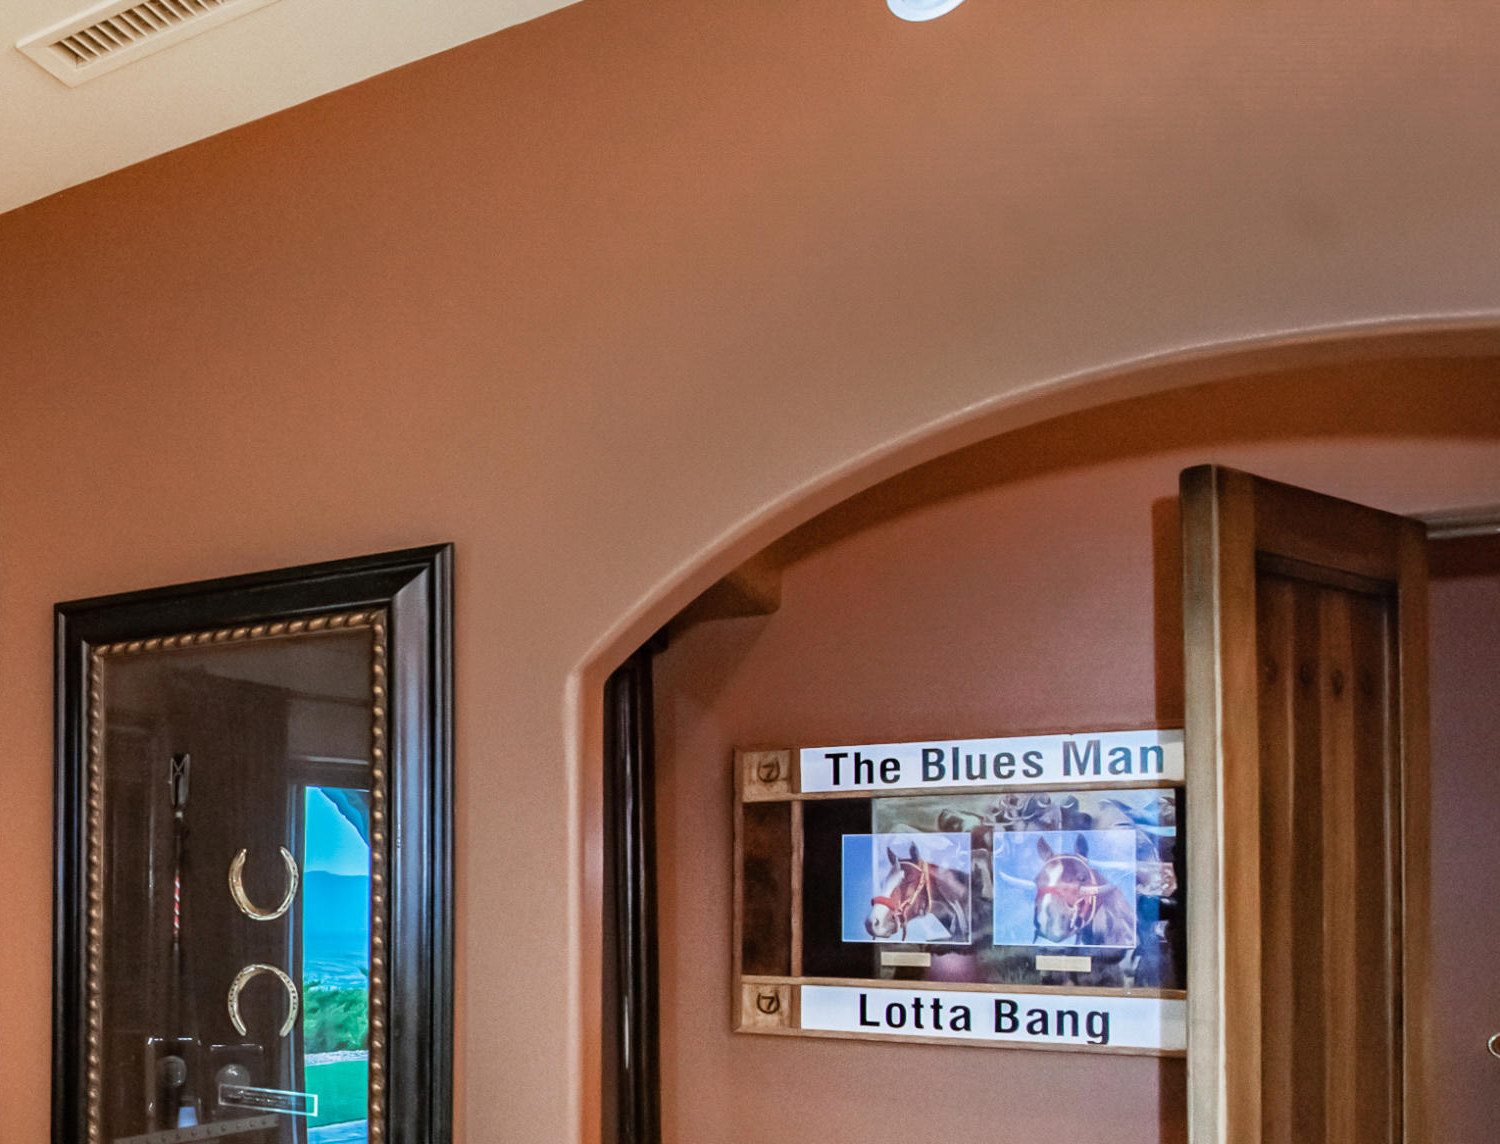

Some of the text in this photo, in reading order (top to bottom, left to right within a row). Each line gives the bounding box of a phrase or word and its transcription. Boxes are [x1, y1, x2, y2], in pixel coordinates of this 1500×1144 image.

[825, 739, 1165, 786] The Blues Man
[858, 993, 1111, 1045] Lotta Bang
